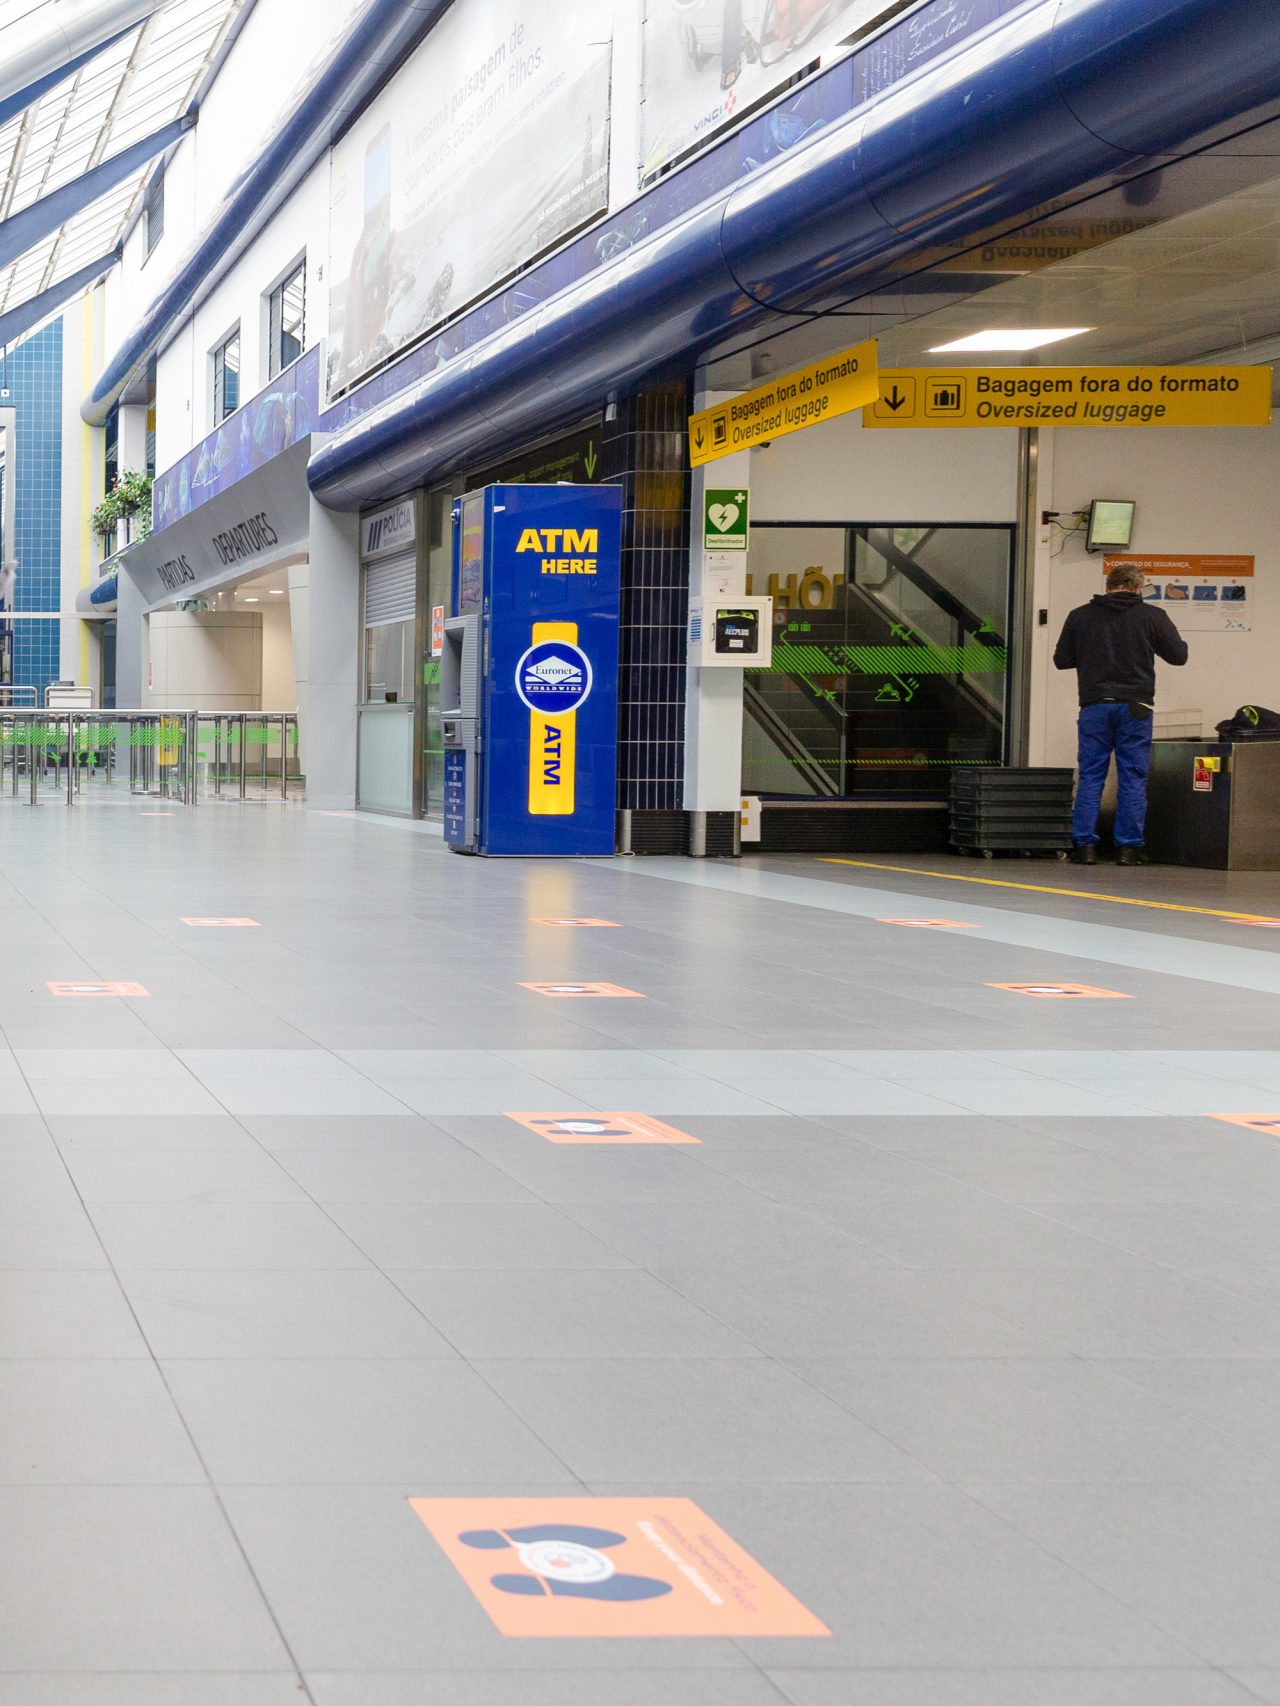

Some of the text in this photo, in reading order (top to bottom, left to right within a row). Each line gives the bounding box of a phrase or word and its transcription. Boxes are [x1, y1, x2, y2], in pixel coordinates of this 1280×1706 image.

[451, 42, 505, 123] paisagem
[509, 21, 524, 53] de
[477, 83, 505, 125] eram
[509, 46, 545, 96] filhos.
[694, 106, 723, 131] VINCI
[731, 358, 859, 422] Bagagem fora do formato
[976, 375, 1239, 397] Bagagem fora do formato
[732, 395, 829, 444] Oversized luggage
[976, 401, 1167, 422] Oversized luggage
[383, 506, 411, 536] POLÍCIA
[212, 512, 278, 565] DEPARTURES
[515, 528, 598, 553] ATM
[156, 554, 195, 591] PARTIDAS
[541, 559, 597, 574] HERE
[535, 665, 573, 675] Euronet
[543, 724, 561, 785] ATM
